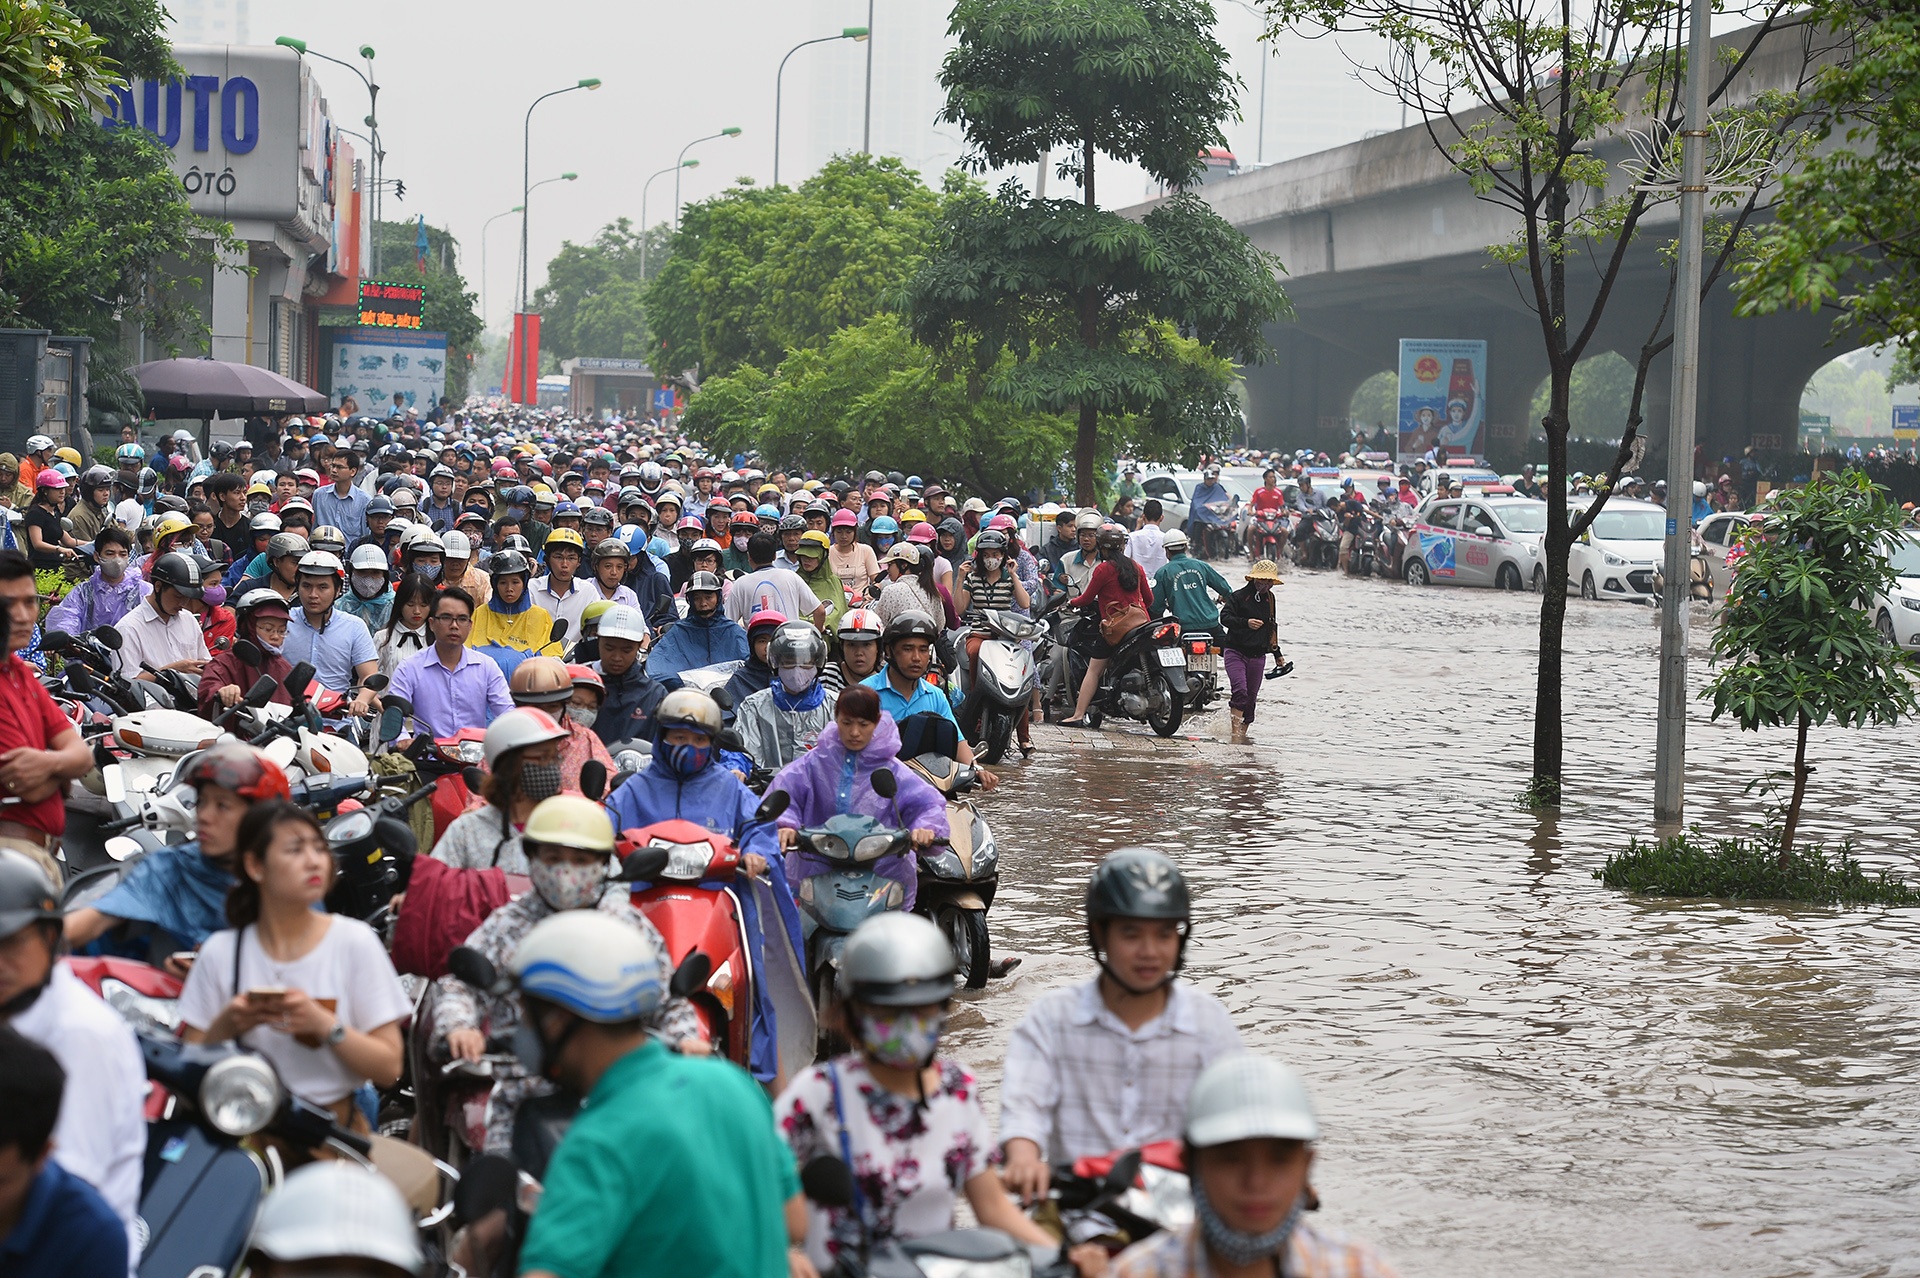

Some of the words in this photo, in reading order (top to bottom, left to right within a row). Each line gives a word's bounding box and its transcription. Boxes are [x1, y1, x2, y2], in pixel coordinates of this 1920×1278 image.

[102, 75, 259, 155] AUTO
[183, 165, 237, 196] ÔTÔ
[1752, 435, 1781, 448] T263
